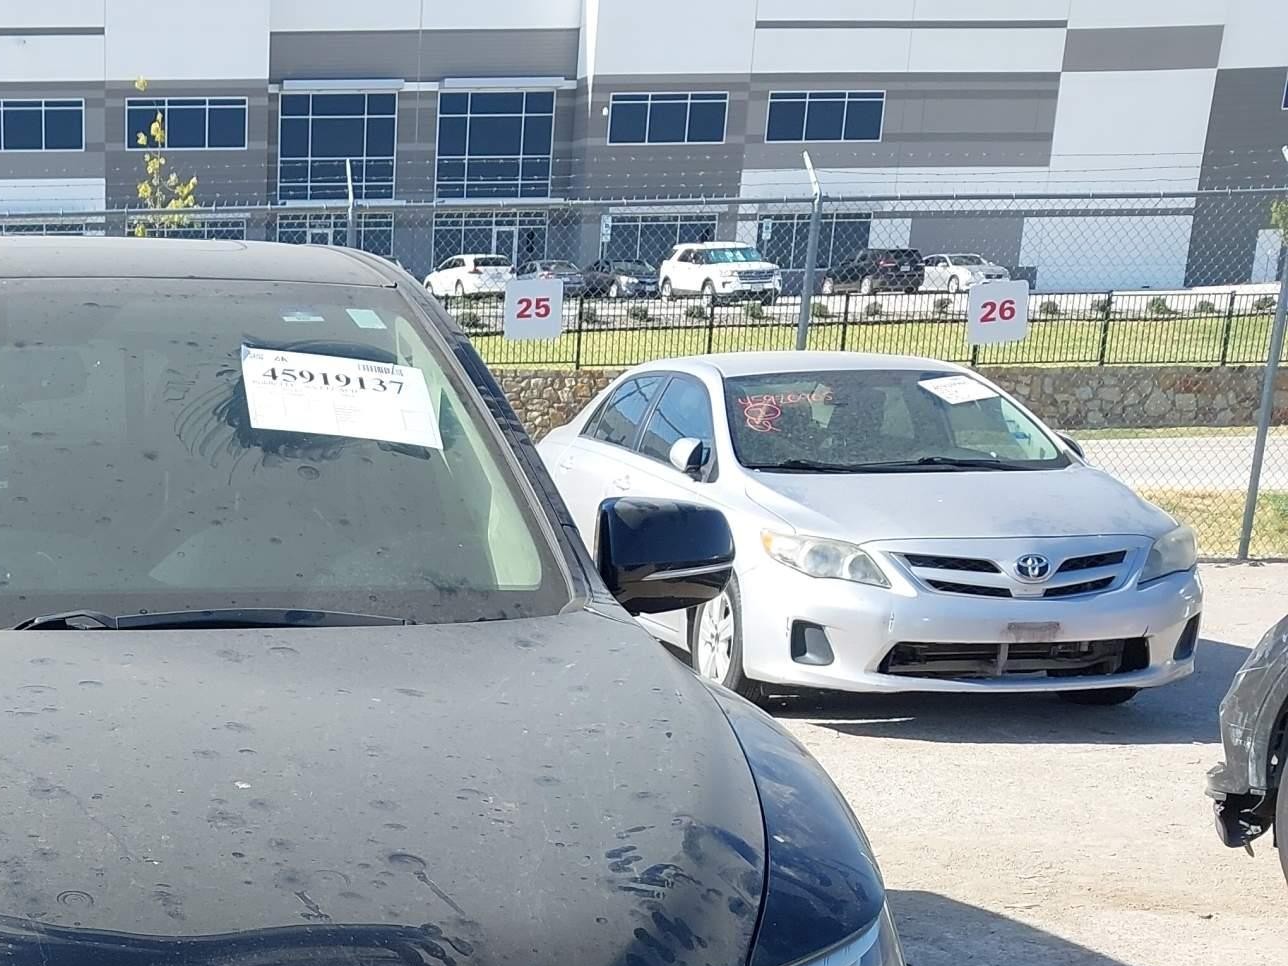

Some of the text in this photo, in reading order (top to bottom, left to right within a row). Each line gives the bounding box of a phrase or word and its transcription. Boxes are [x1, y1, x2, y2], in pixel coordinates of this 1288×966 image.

[516, 297, 551, 319] 25
[980, 299, 1016, 323] 26
[262, 366, 404, 395] 45919137
